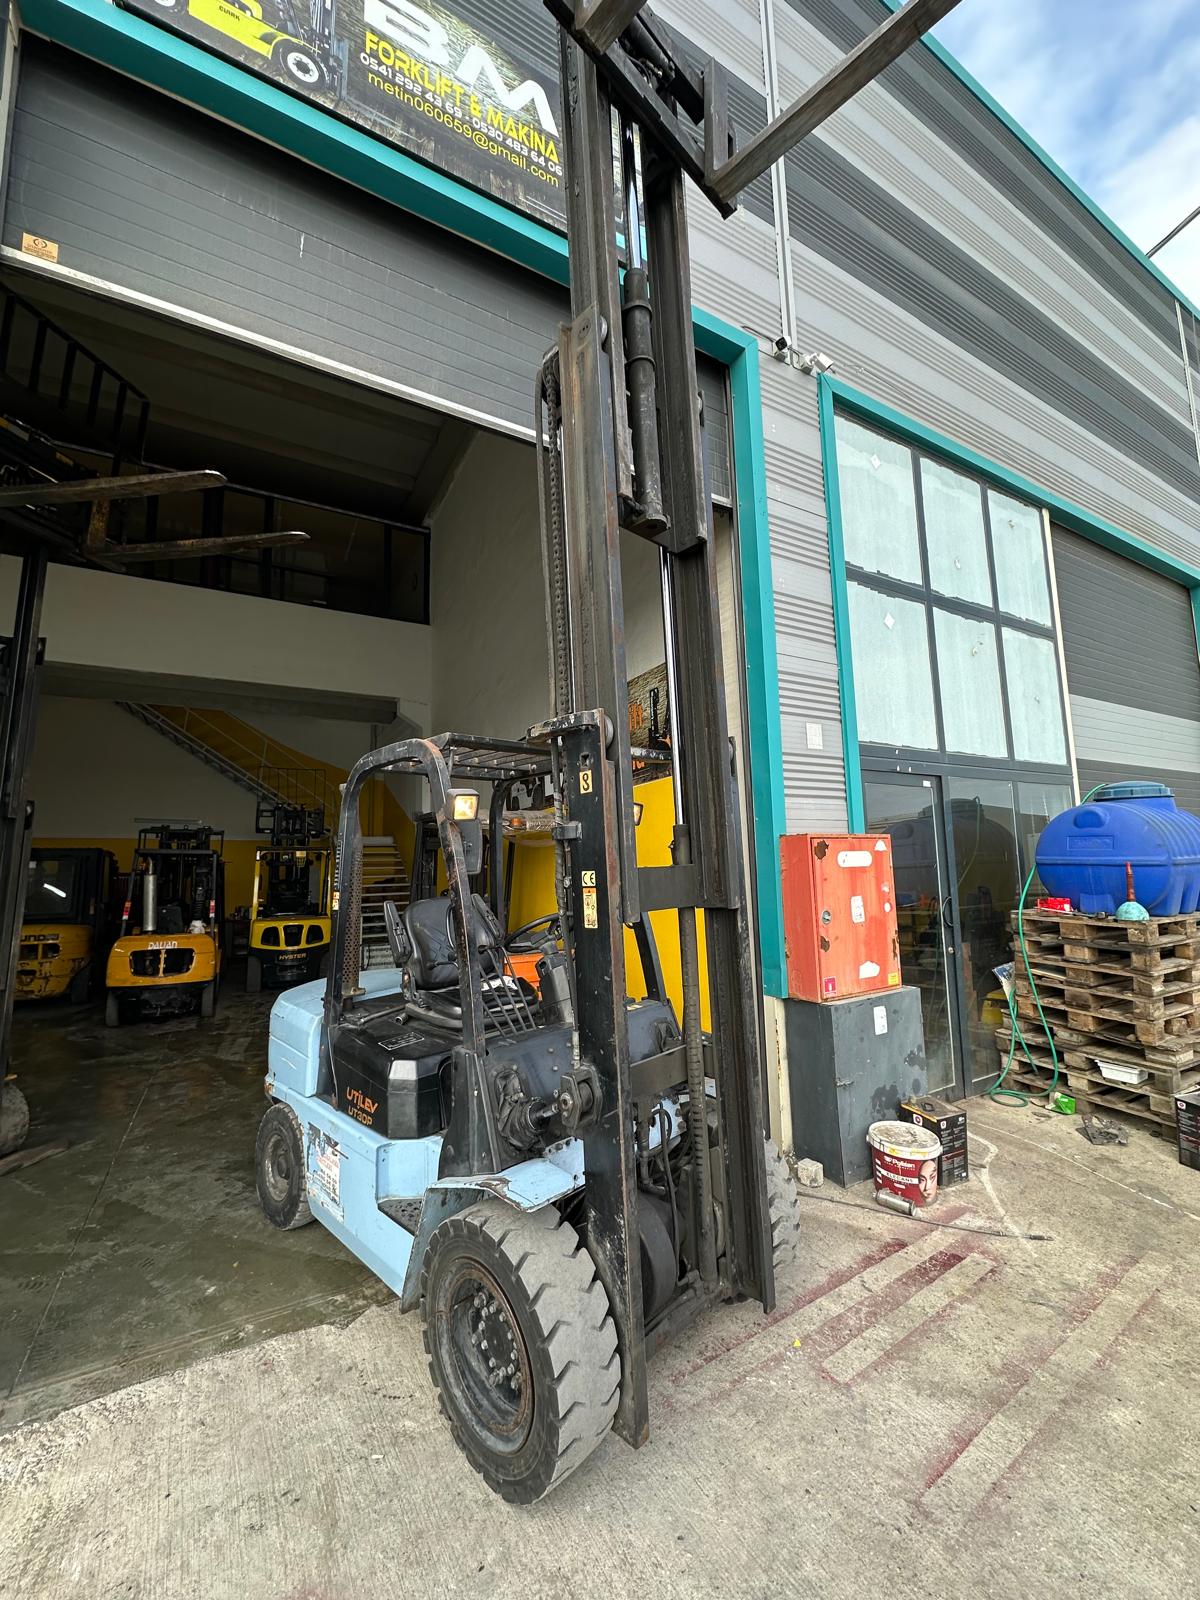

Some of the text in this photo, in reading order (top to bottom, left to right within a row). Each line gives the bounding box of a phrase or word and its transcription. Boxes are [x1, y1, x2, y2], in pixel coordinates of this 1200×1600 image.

[360, 52, 392, 79] 0541
[395, 72, 422, 95] 292
[425, 91, 442, 107] 43
[445, 101, 462, 118] 69
[472, 117, 503, 142] 0530
[505, 137, 528, 157] 483
[530, 150, 546, 167] 64
[547, 160, 563, 177] 06
[365, 31, 465, 107] FORKLIFT
[470, 94, 482, 118] &
[368, 72, 559, 187] metin060659@gmail.com
